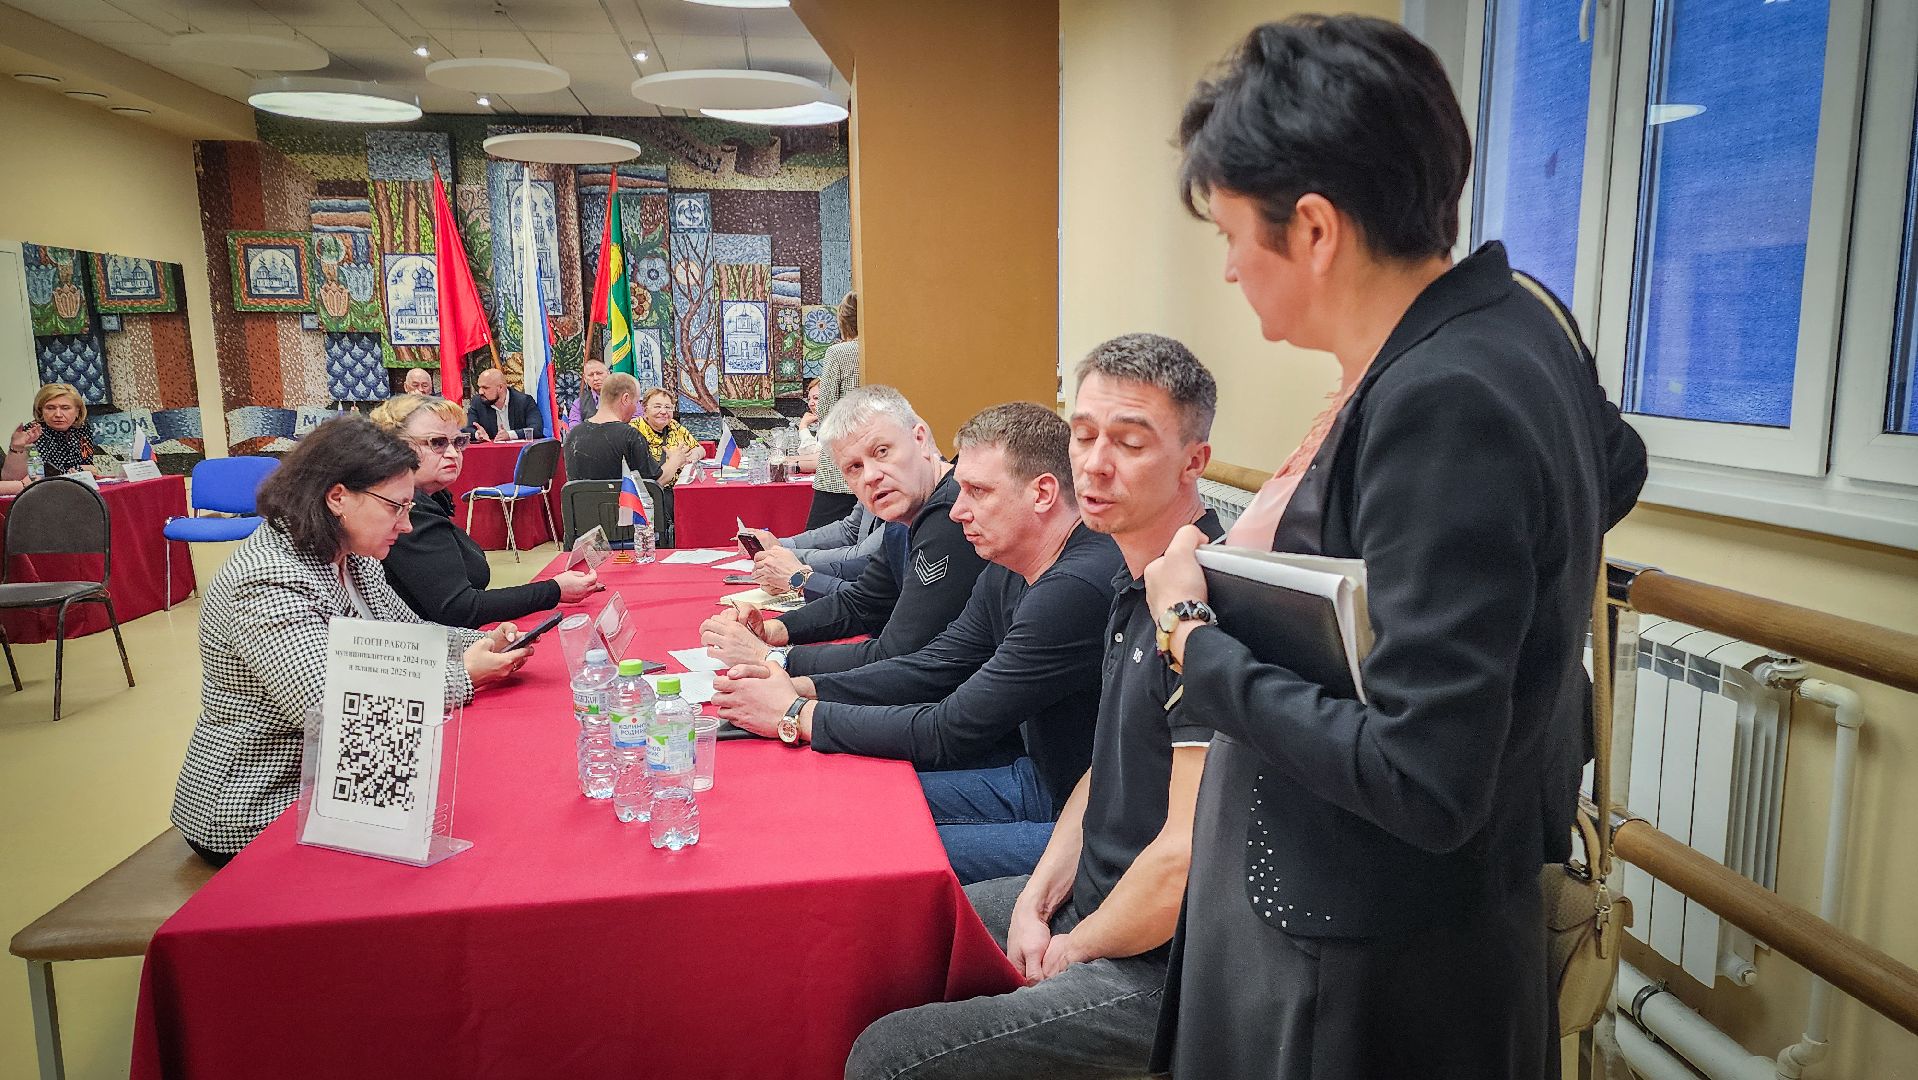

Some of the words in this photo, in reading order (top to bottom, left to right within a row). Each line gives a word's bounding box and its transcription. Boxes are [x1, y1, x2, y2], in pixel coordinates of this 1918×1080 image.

[353, 636, 382, 647] ИТОГИ
[384, 639, 419, 651] РАБОТЫ
[402, 655, 419, 664] 2024
[420, 658, 437, 668] году
[354, 665, 378, 674] планы
[390, 667, 407, 677] 2025
[408, 671, 421, 679] год
